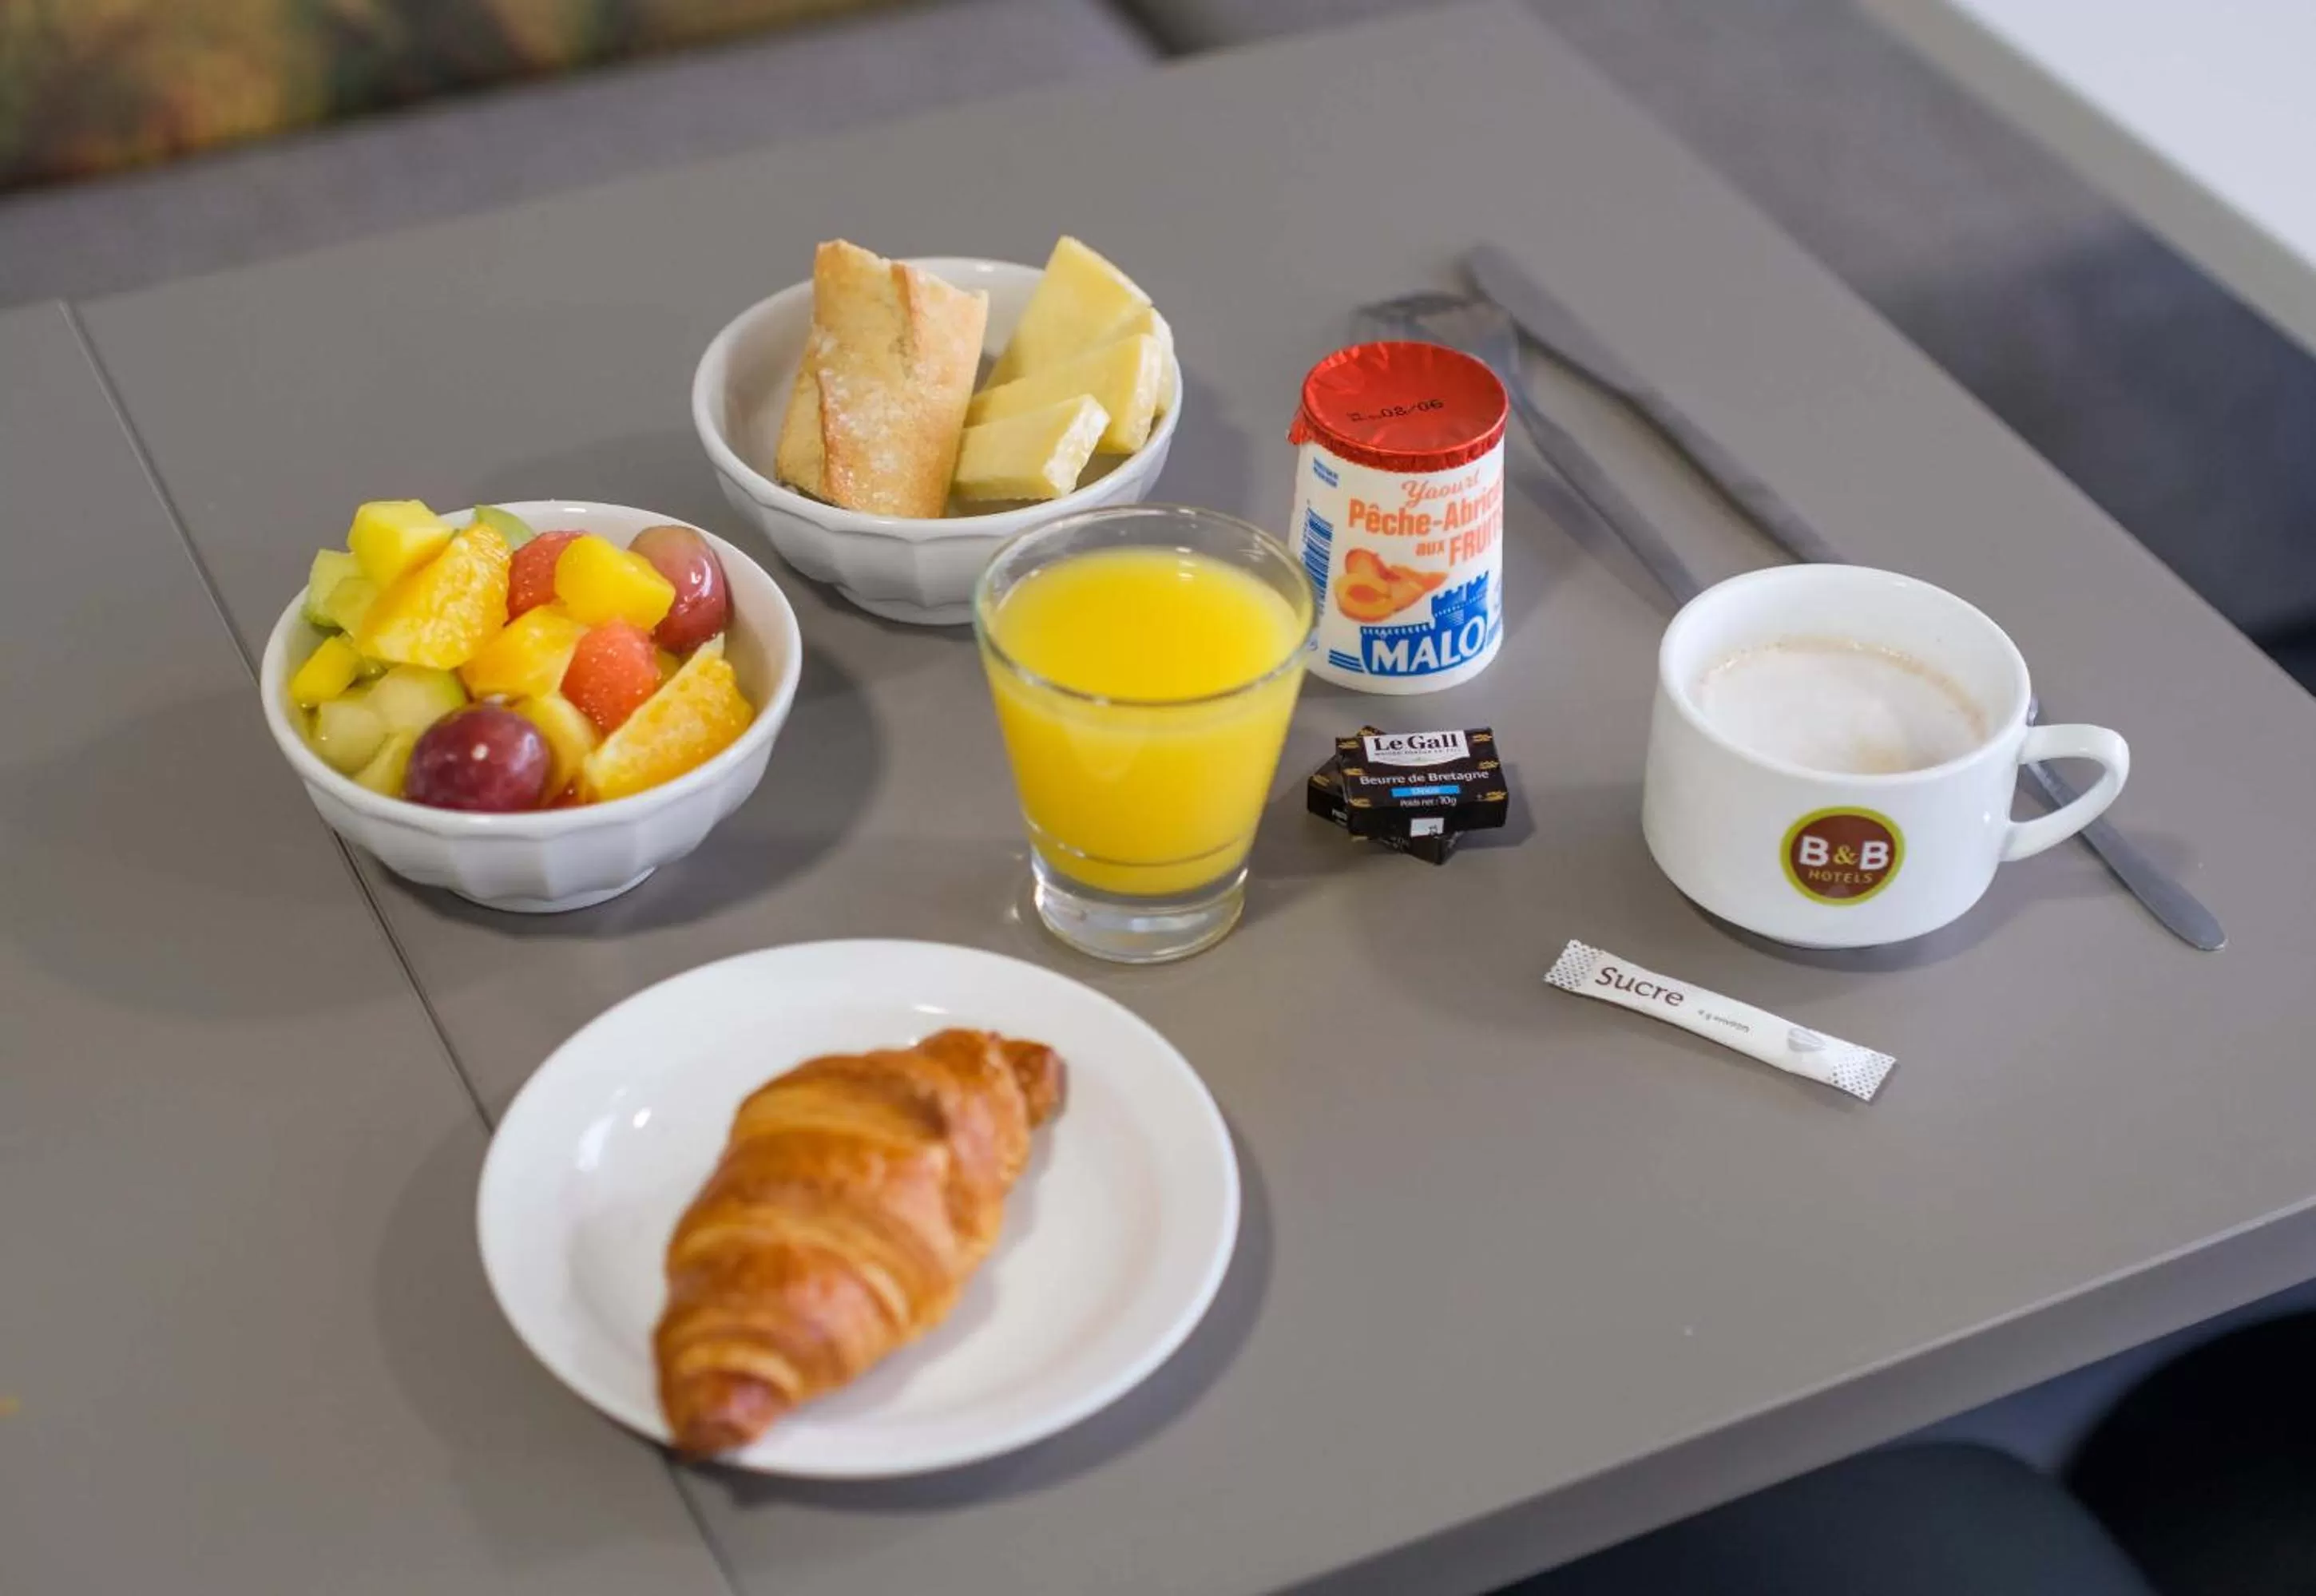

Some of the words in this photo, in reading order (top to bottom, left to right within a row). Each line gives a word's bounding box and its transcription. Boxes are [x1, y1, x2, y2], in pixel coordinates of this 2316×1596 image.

[1401, 468, 1480, 509] Yaourt
[1415, 539, 1445, 556] aux
[1449, 509, 1501, 567] FRUIT
[1370, 615, 1486, 672] MALO
[1374, 737, 1403, 750] Le
[1406, 733, 1458, 750] Gall
[1359, 774, 1406, 786] Beurre
[1408, 773, 1426, 783] de
[1427, 770, 1489, 782] Bretagne
[1808, 867, 1874, 885] HOTELS
[1594, 967, 1684, 1008] Sucre
